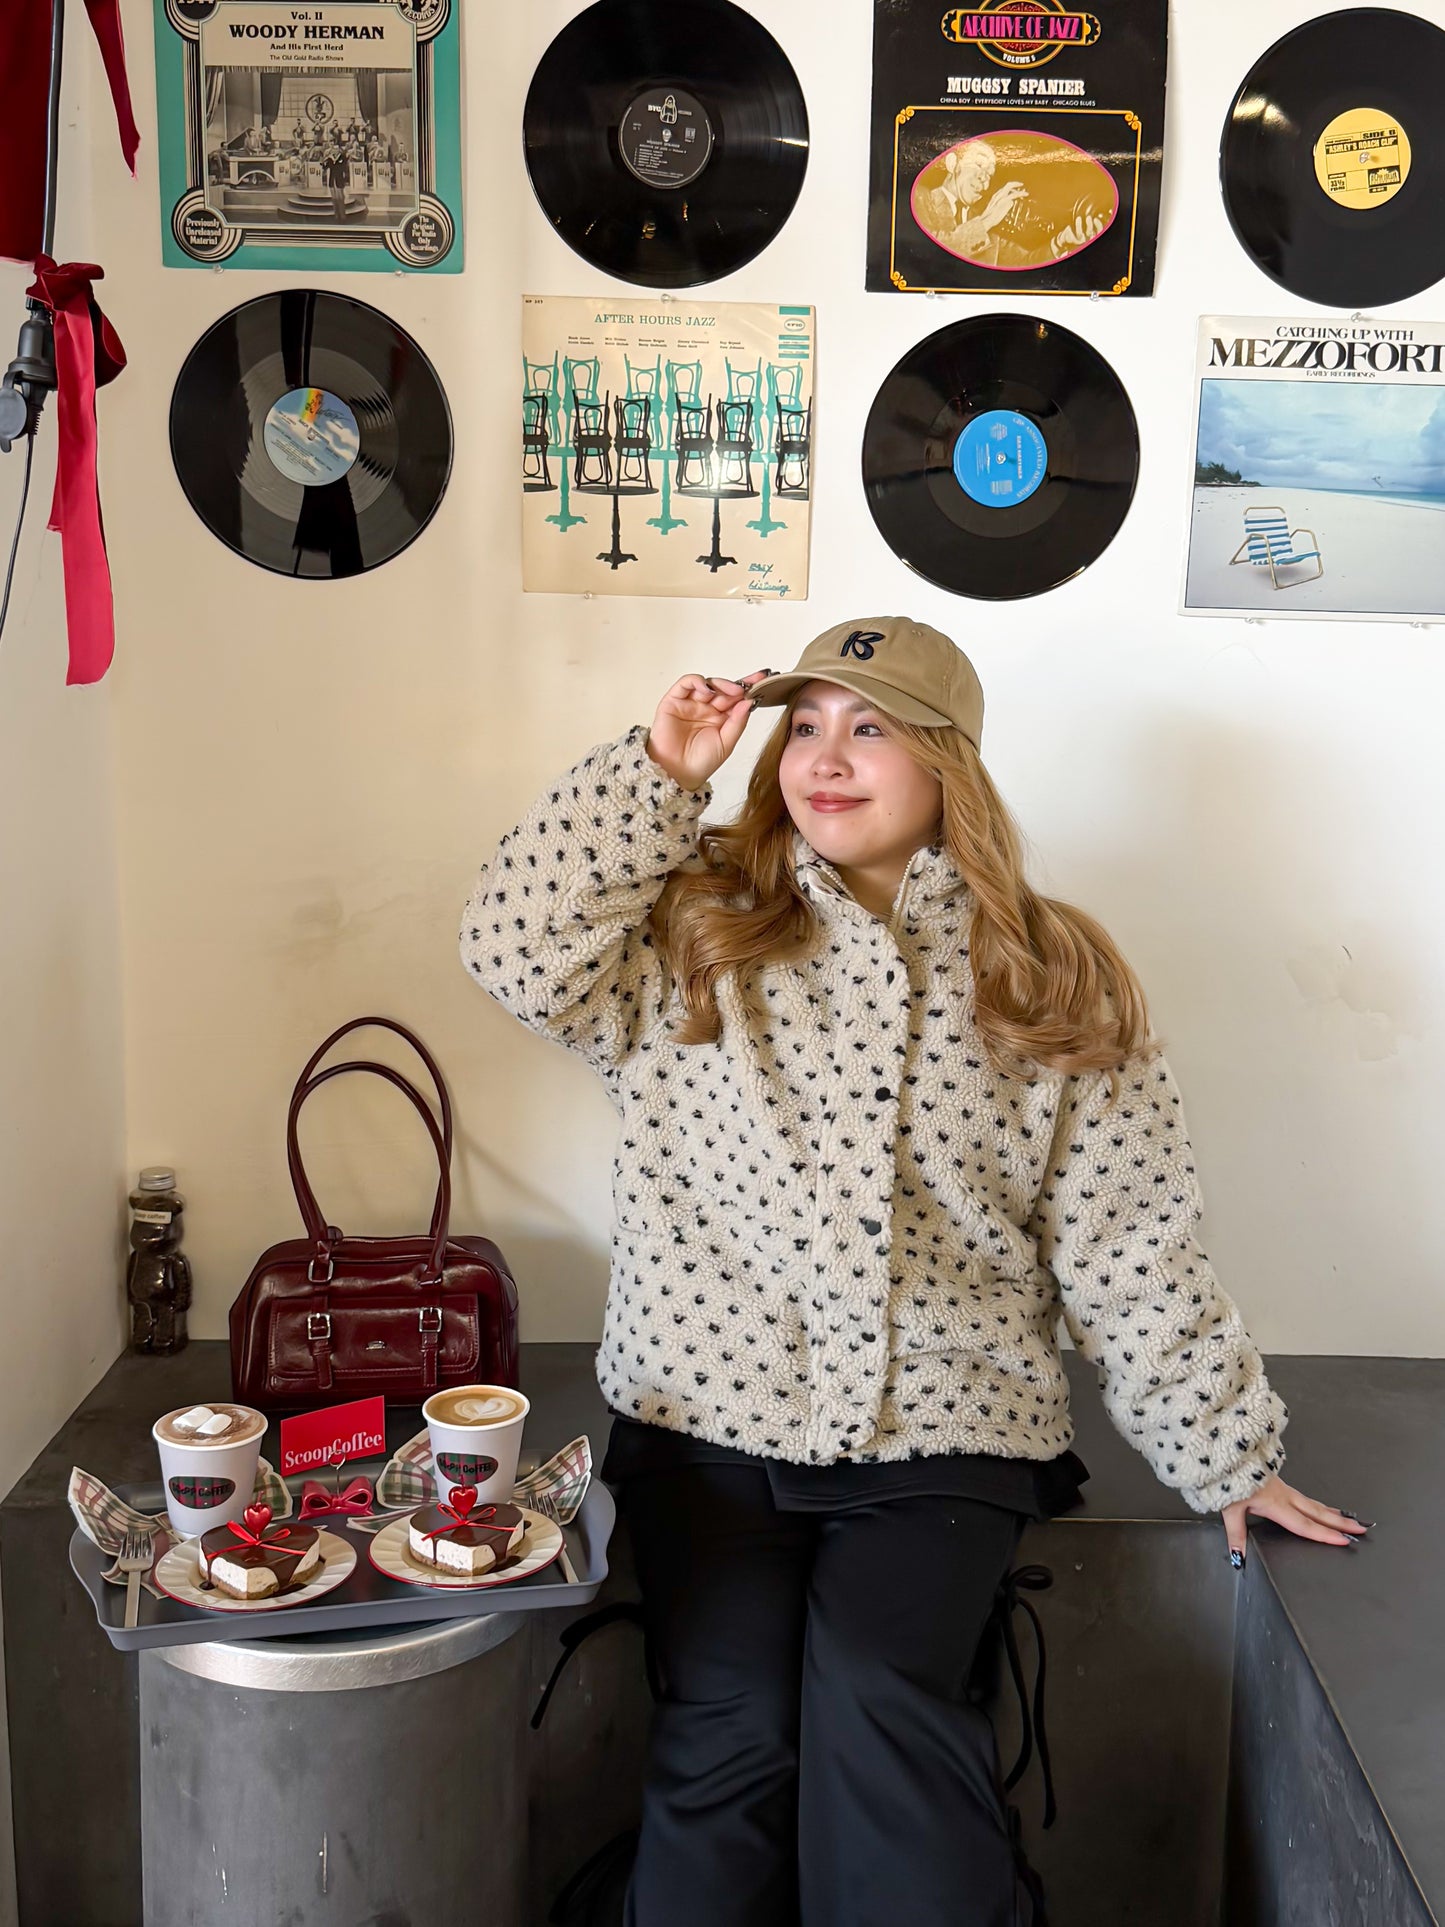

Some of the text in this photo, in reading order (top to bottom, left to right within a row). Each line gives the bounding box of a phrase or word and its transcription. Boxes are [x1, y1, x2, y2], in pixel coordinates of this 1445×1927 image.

[291, 12, 323, 20] Vol. II
[228, 24, 385, 40] WOODY HERMAN
[962, 15, 1080, 40] ARCHIVE OF JAZZ
[946, 76, 1086, 96] MUGGSY SPANIER
[1362, 130, 1385, 140] SIDE
[594, 314, 716, 327] AFTER HOURS JAZZ
[1276, 326, 1414, 341] CATCHING UP WITH
